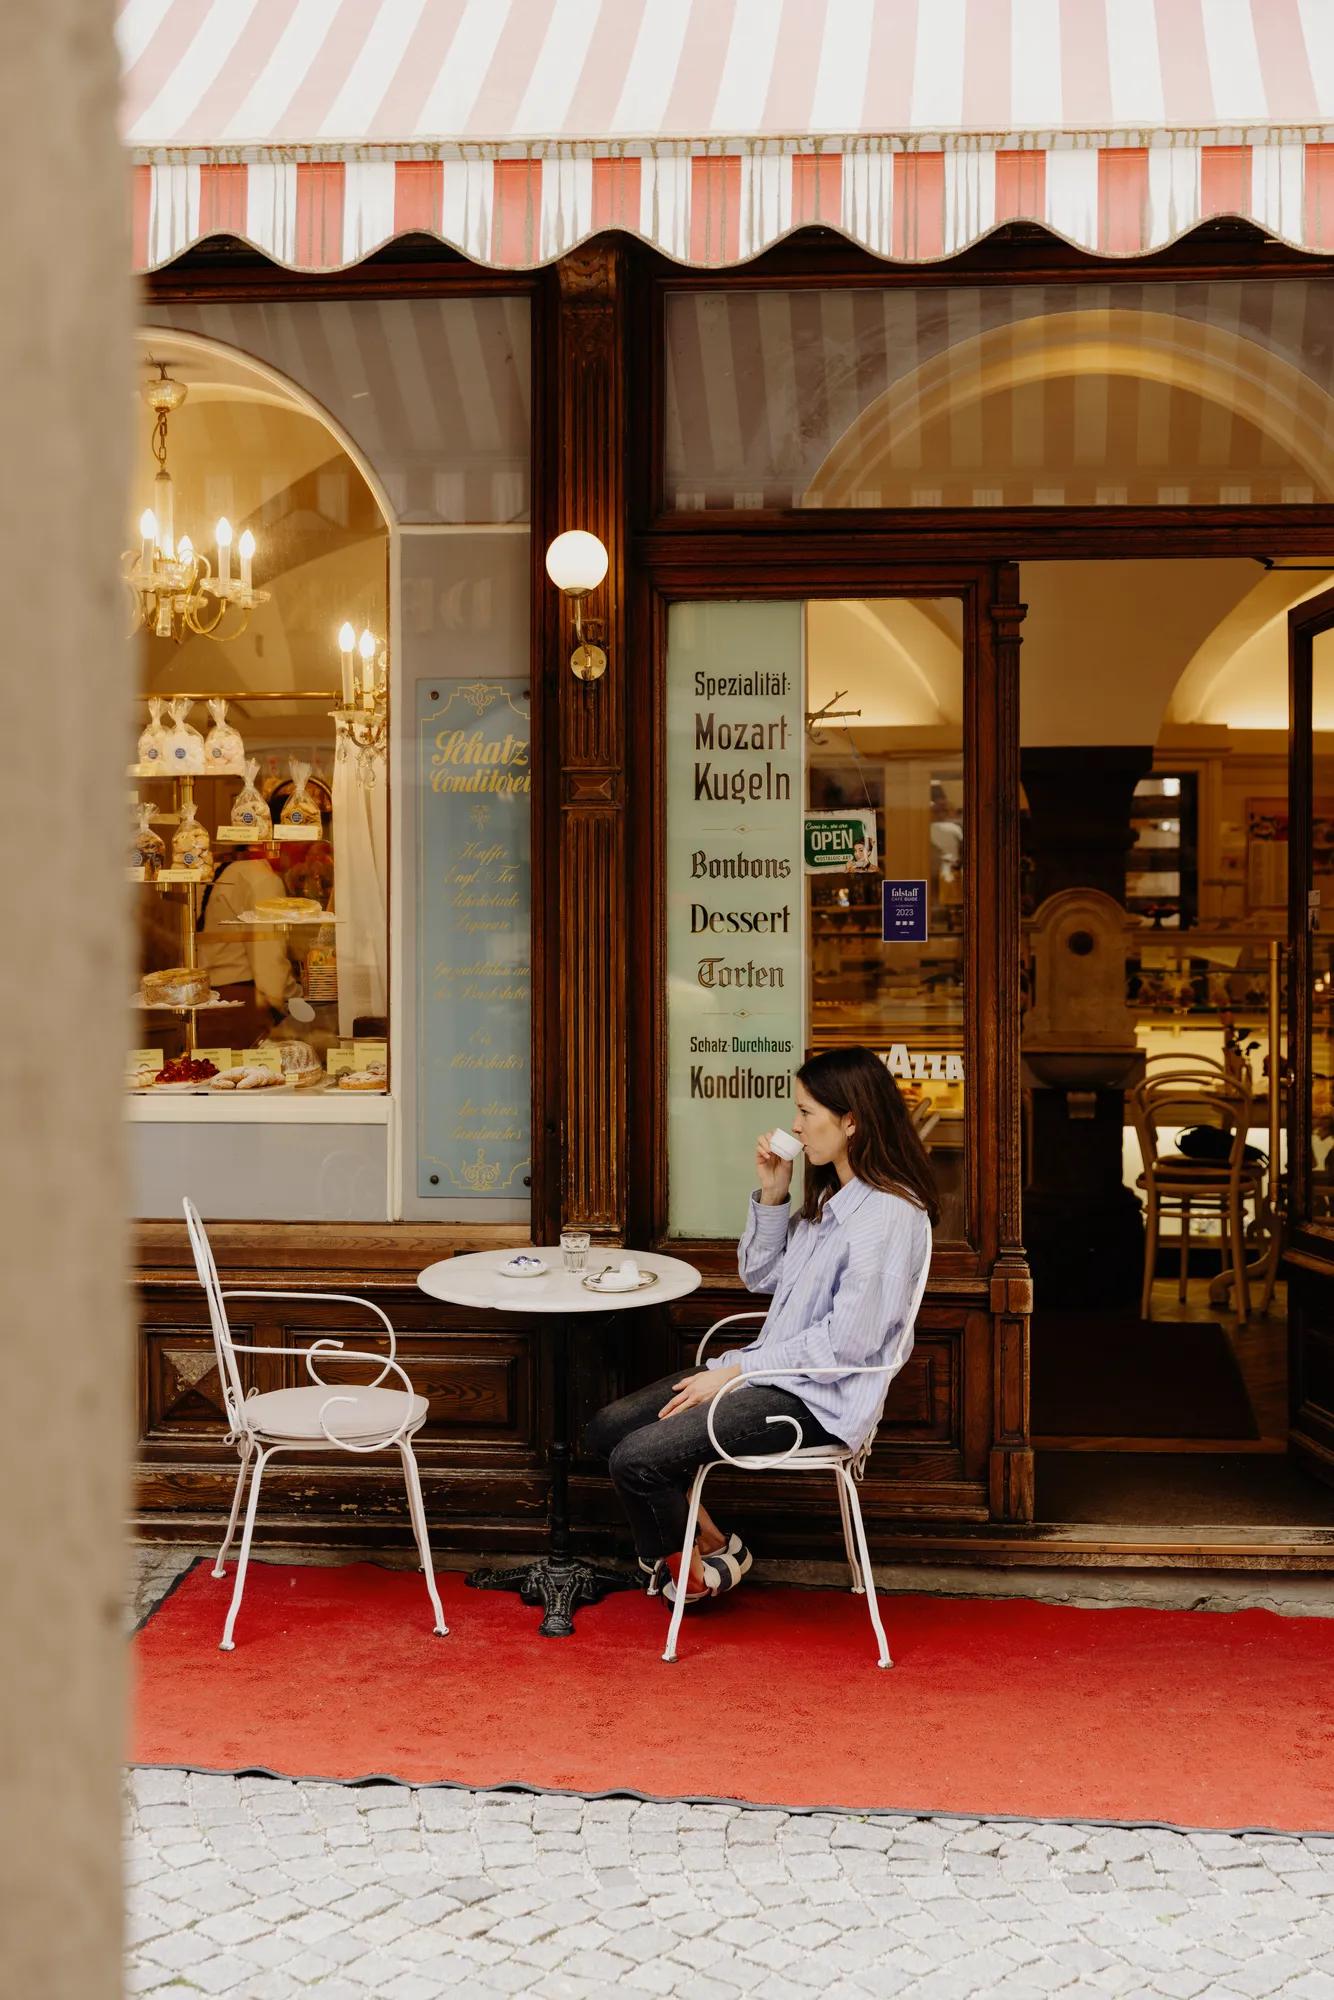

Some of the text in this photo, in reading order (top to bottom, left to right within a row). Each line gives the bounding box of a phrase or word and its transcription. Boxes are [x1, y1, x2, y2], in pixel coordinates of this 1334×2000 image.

[694, 671, 791, 700] Spezialität:
[431, 729, 529, 767] Schatz
[694, 762, 791, 804] Kugeln
[811, 829, 853, 850] OPEN
[691, 850, 791, 879] Bonbons
[891, 888, 919, 897] falstaff
[690, 903, 791, 934] Dessert
[895, 908, 914, 917] 2023
[697, 956, 785, 989] Torten
[690, 1065, 791, 1099] Konditorei
